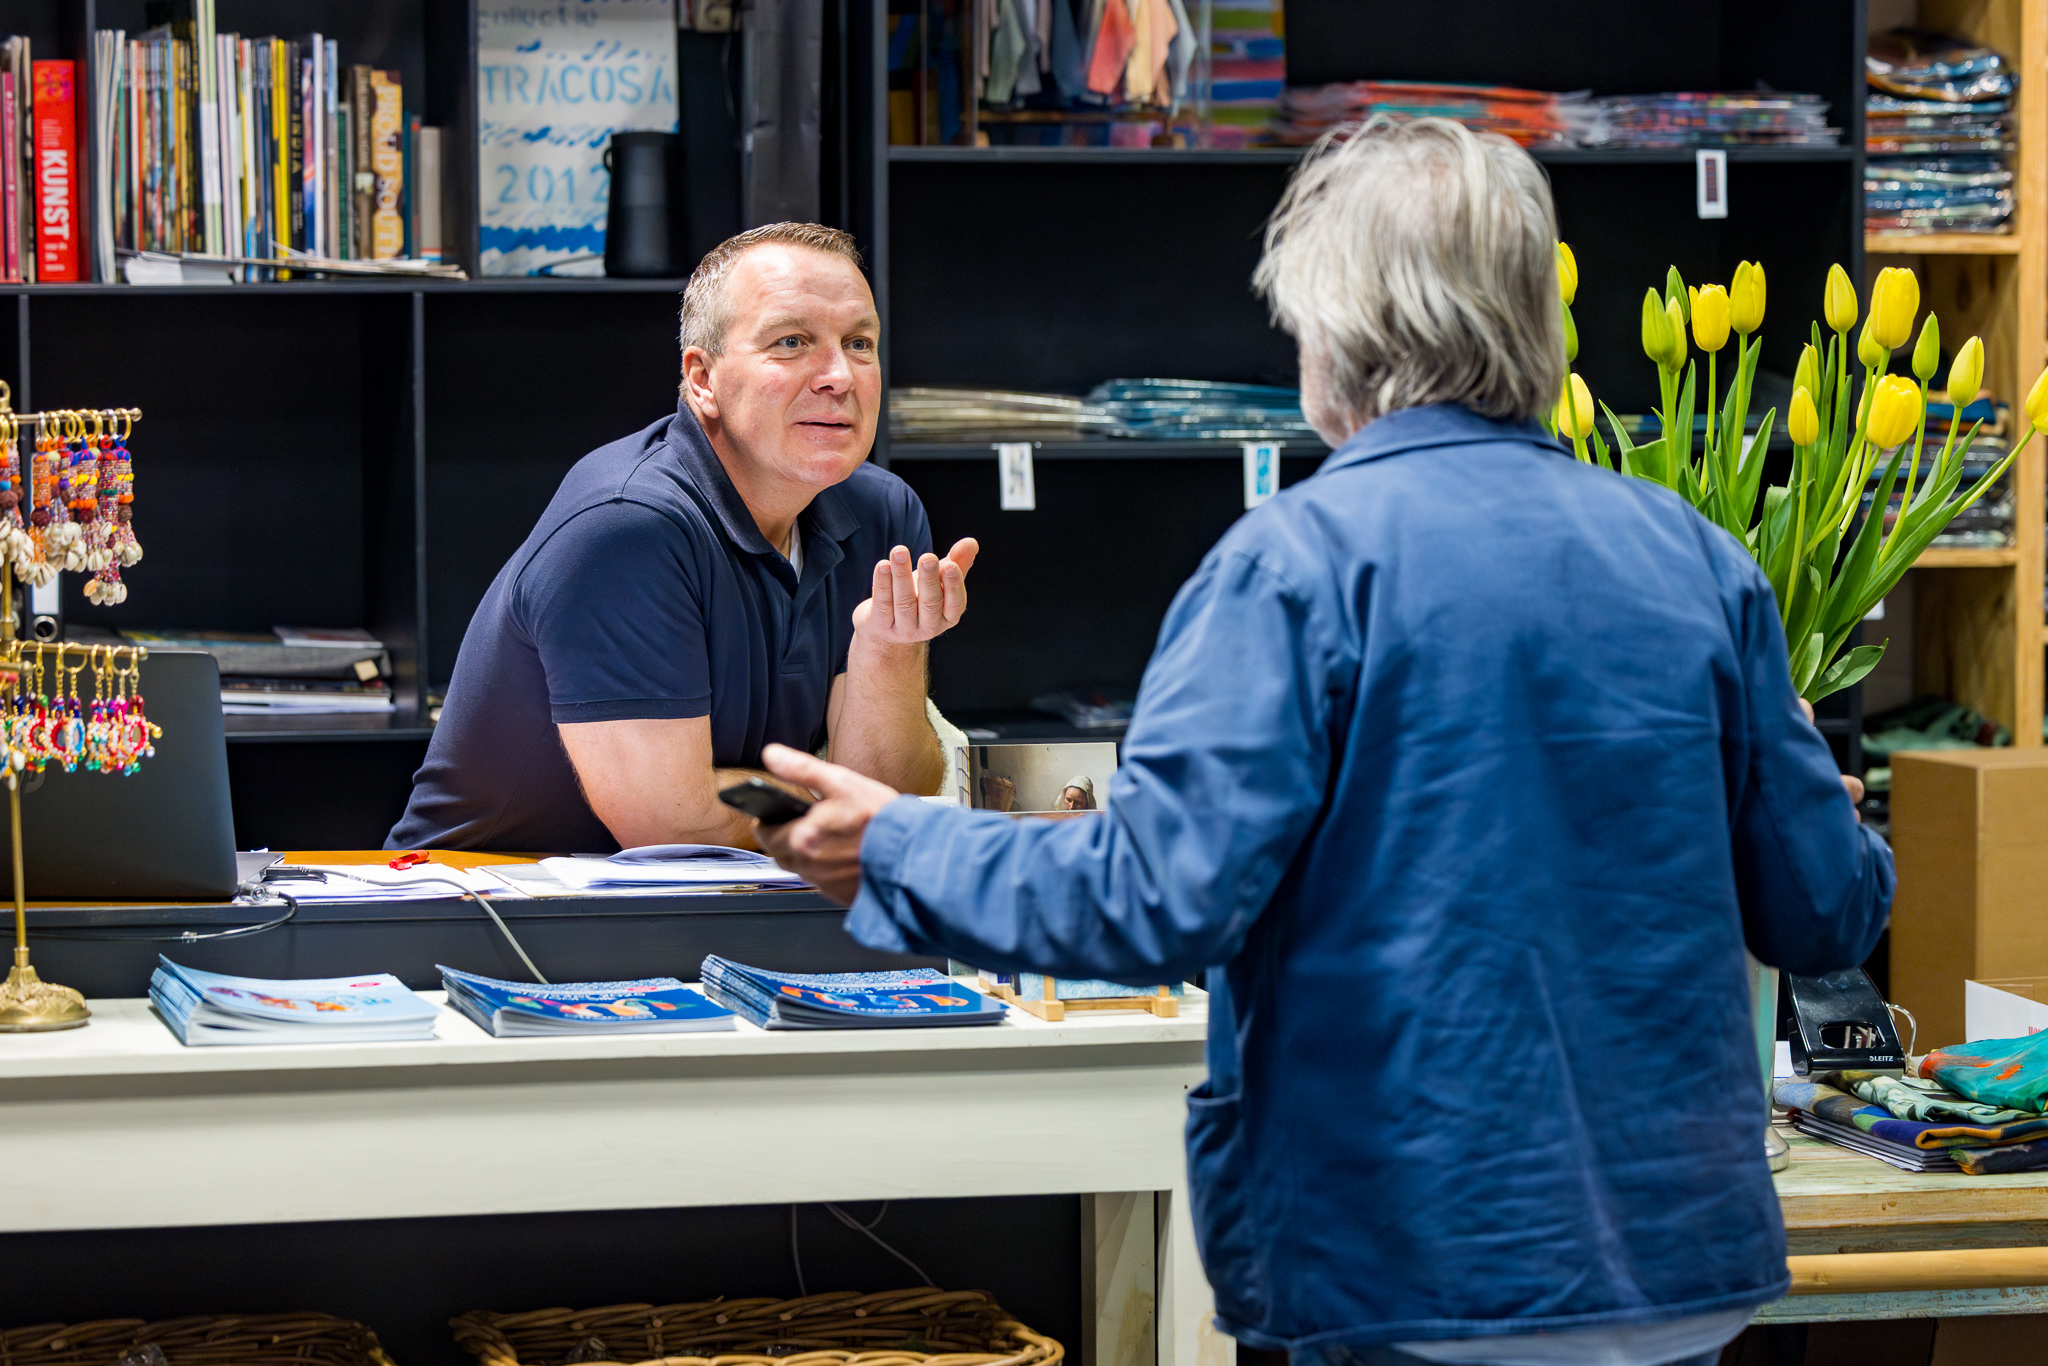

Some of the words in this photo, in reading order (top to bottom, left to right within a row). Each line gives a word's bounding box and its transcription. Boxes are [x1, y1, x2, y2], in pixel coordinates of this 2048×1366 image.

[481, 63, 673, 105] TRACOSA
[375, 84, 398, 172] PROUD
[41, 149, 70, 240] KUNST
[497, 163, 609, 204] 2012
